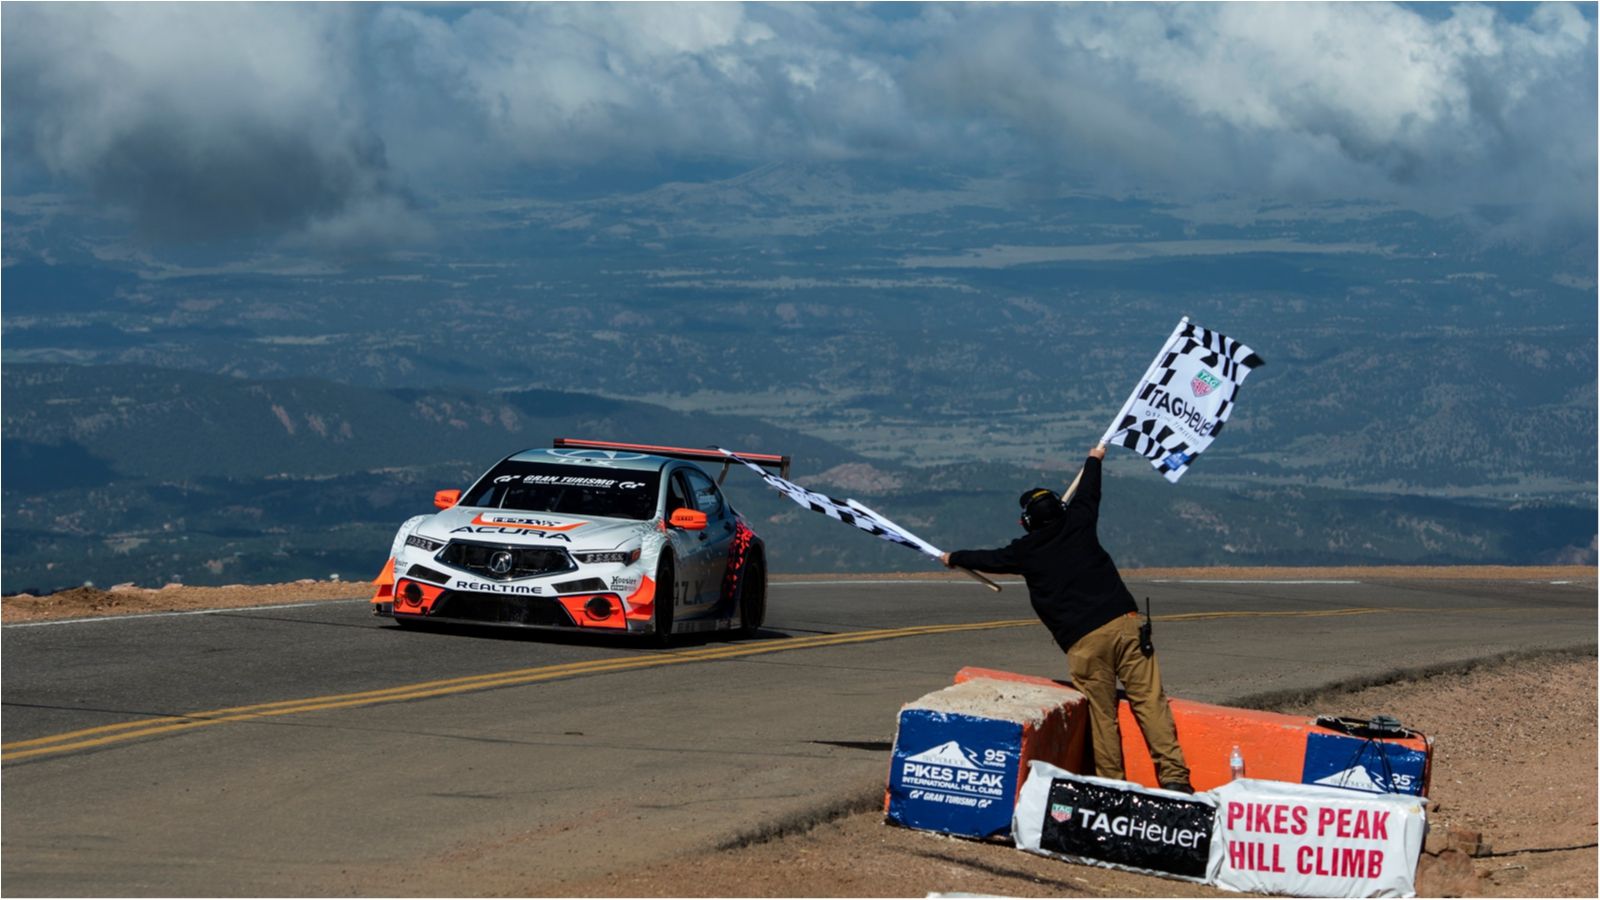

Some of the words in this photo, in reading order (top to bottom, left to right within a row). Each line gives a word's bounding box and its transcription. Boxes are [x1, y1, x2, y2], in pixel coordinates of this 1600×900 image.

[562, 476, 616, 486] TURISMO
[449, 526, 572, 542] ACURA
[456, 581, 543, 594] REALTIME
[903, 763, 953, 782] PIKES
[956, 770, 1004, 788] PEAK
[902, 776, 960, 790] INTERNATIONAL
[961, 783, 978, 793] HILL
[978, 786, 1003, 796] CLIMB
[923, 791, 944, 802] GRAN
[945, 794, 977, 807] TURISMO
[1078, 808, 1207, 849] TAGHeuer
[1227, 802, 1309, 836] PIKES
[1317, 807, 1390, 840] PEAK
[1229, 840, 1285, 873] HILL
[1296, 846, 1384, 879] CLIMB
